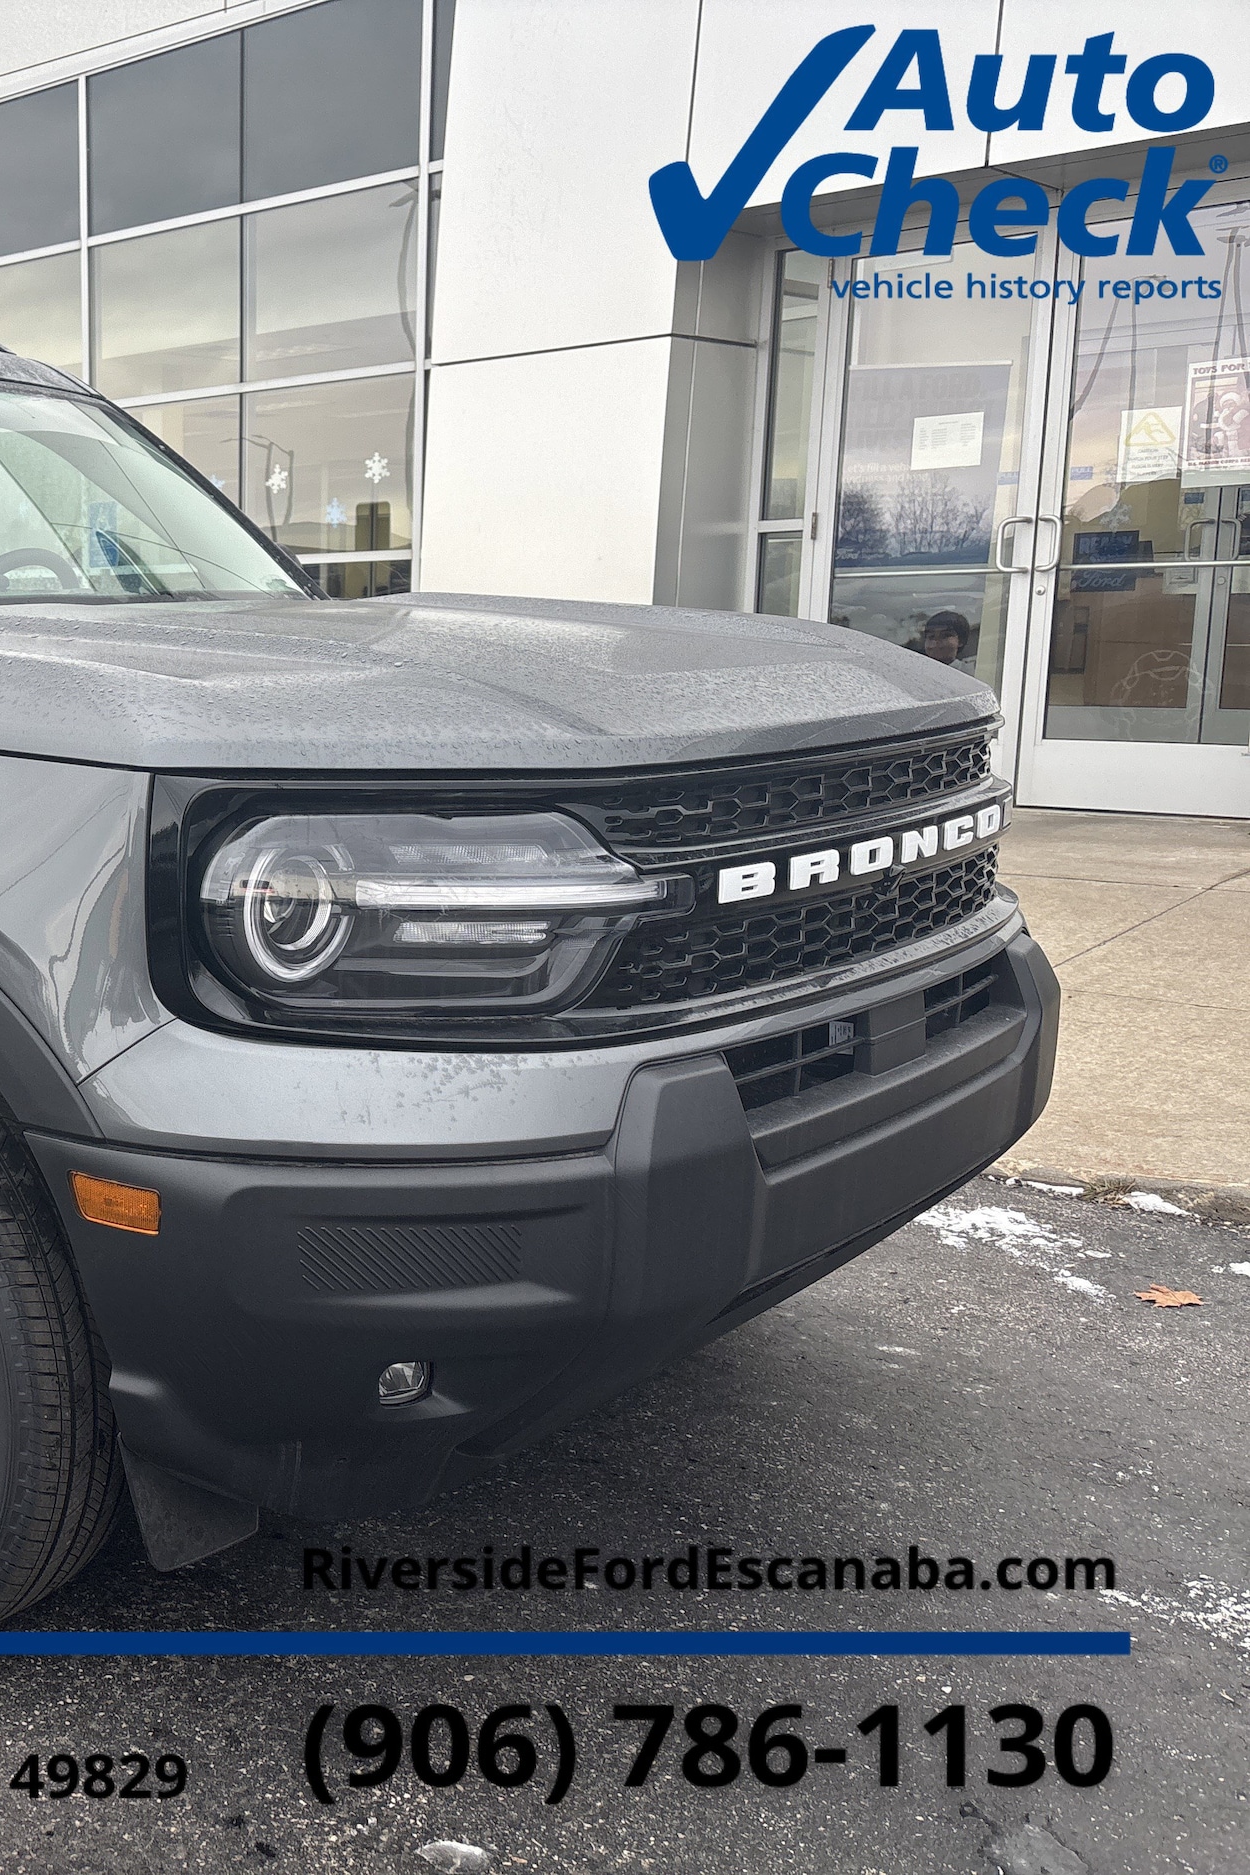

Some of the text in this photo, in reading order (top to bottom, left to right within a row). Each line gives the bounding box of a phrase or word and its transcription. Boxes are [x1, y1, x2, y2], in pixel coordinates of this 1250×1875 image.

[1193, 363, 1245, 375] TOYS FOR
[1078, 568, 1127, 588] Ford
[718, 804, 1001, 904] BRONCO
